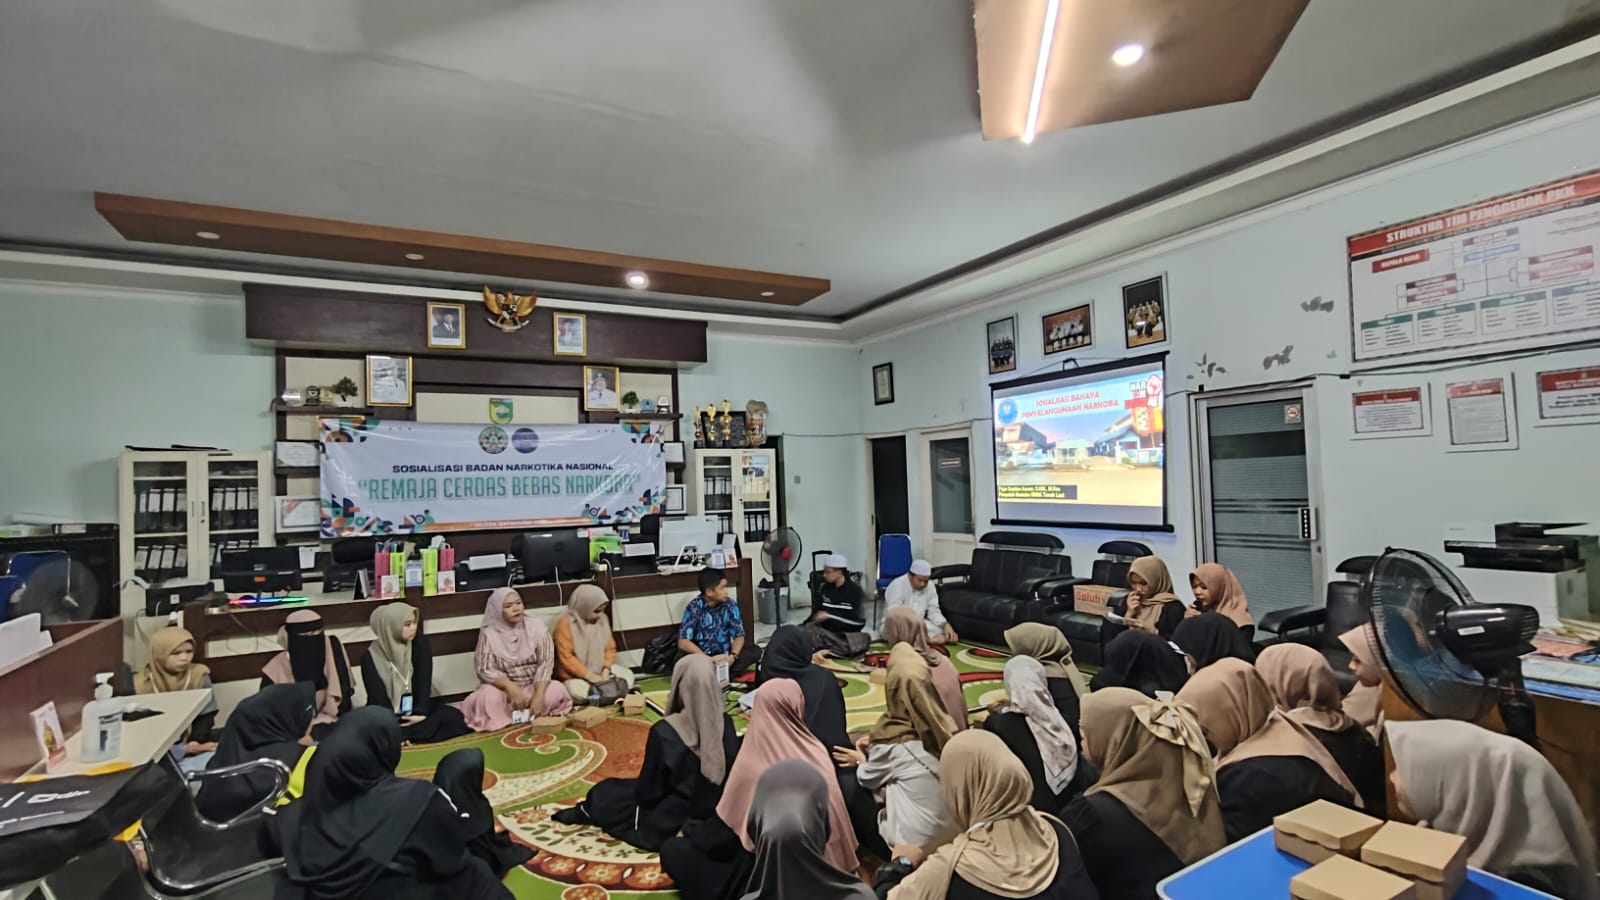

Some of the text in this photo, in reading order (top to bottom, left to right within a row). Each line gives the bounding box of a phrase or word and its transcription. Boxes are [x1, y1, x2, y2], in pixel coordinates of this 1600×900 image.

[1071, 391, 1100, 402] BAHAYA
[392, 463, 614, 473] SOSIALISASI BADAN NARKOTIKA NASIONAL
[443, 476, 506, 498] CERDAS
[511, 475, 561, 496] BEBAS
